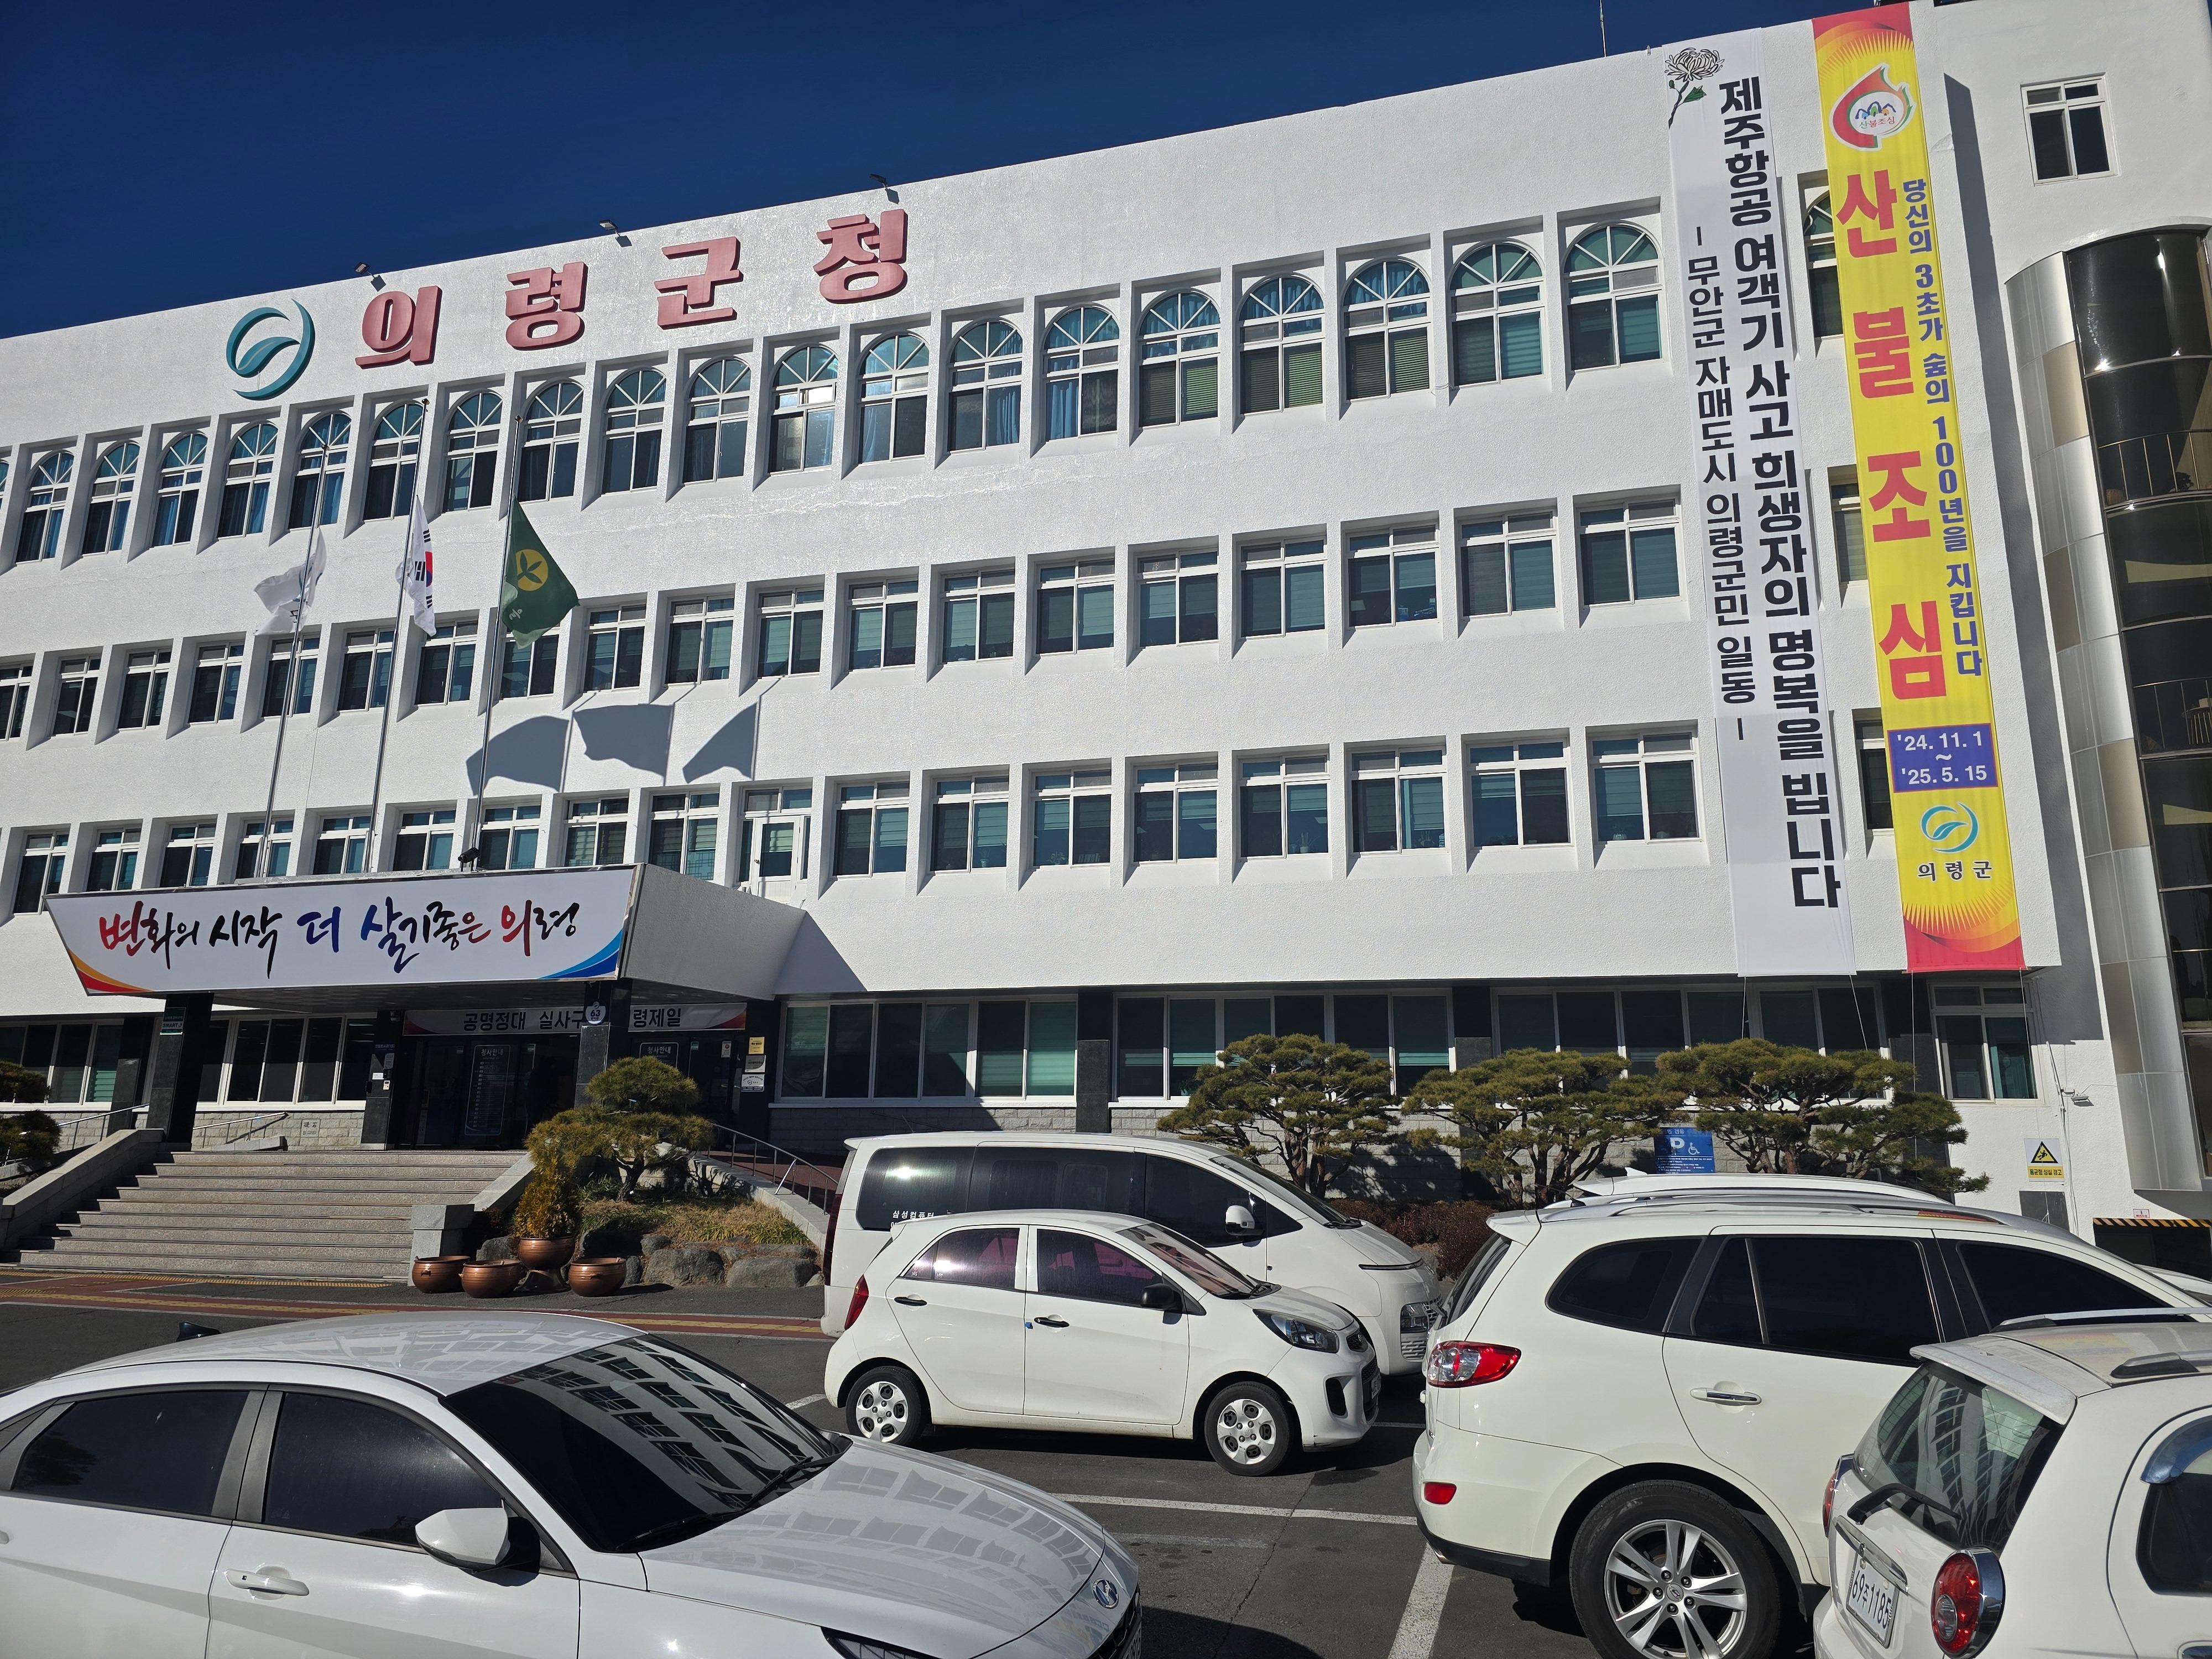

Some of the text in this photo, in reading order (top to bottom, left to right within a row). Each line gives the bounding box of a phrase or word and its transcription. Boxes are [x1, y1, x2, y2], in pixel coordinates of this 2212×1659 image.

[1859, 116, 1895, 129] 산불조심
[354, 208, 908, 369] 의령군청
[1688, 256, 1725, 348] 무안군
[1695, 356, 1736, 484] 자매도시
[1837, 170, 1947, 700] 산불조심
[1903, 179, 1983, 676] 당신의 3초가 숲의 100년을 지킵니다
[1719, 76, 1841, 907] 제주항공 여객기 사고 희생자의 명복을 빕니다
[1707, 493, 1749, 626] 의령군민
[1717, 636, 1755, 703] 일동
[1965, 765, 1987, 781] 15
[1973, 731, 1981, 746] 1
[1918, 860, 1992, 881] 의령군
[99, 896, 580, 979] 변화의 시작 더 살기좋은 의령
[463, 1008, 681, 1031] 공명정대 실사구 령제일
[893, 1210, 934, 1219] 삼성컴퓨터
